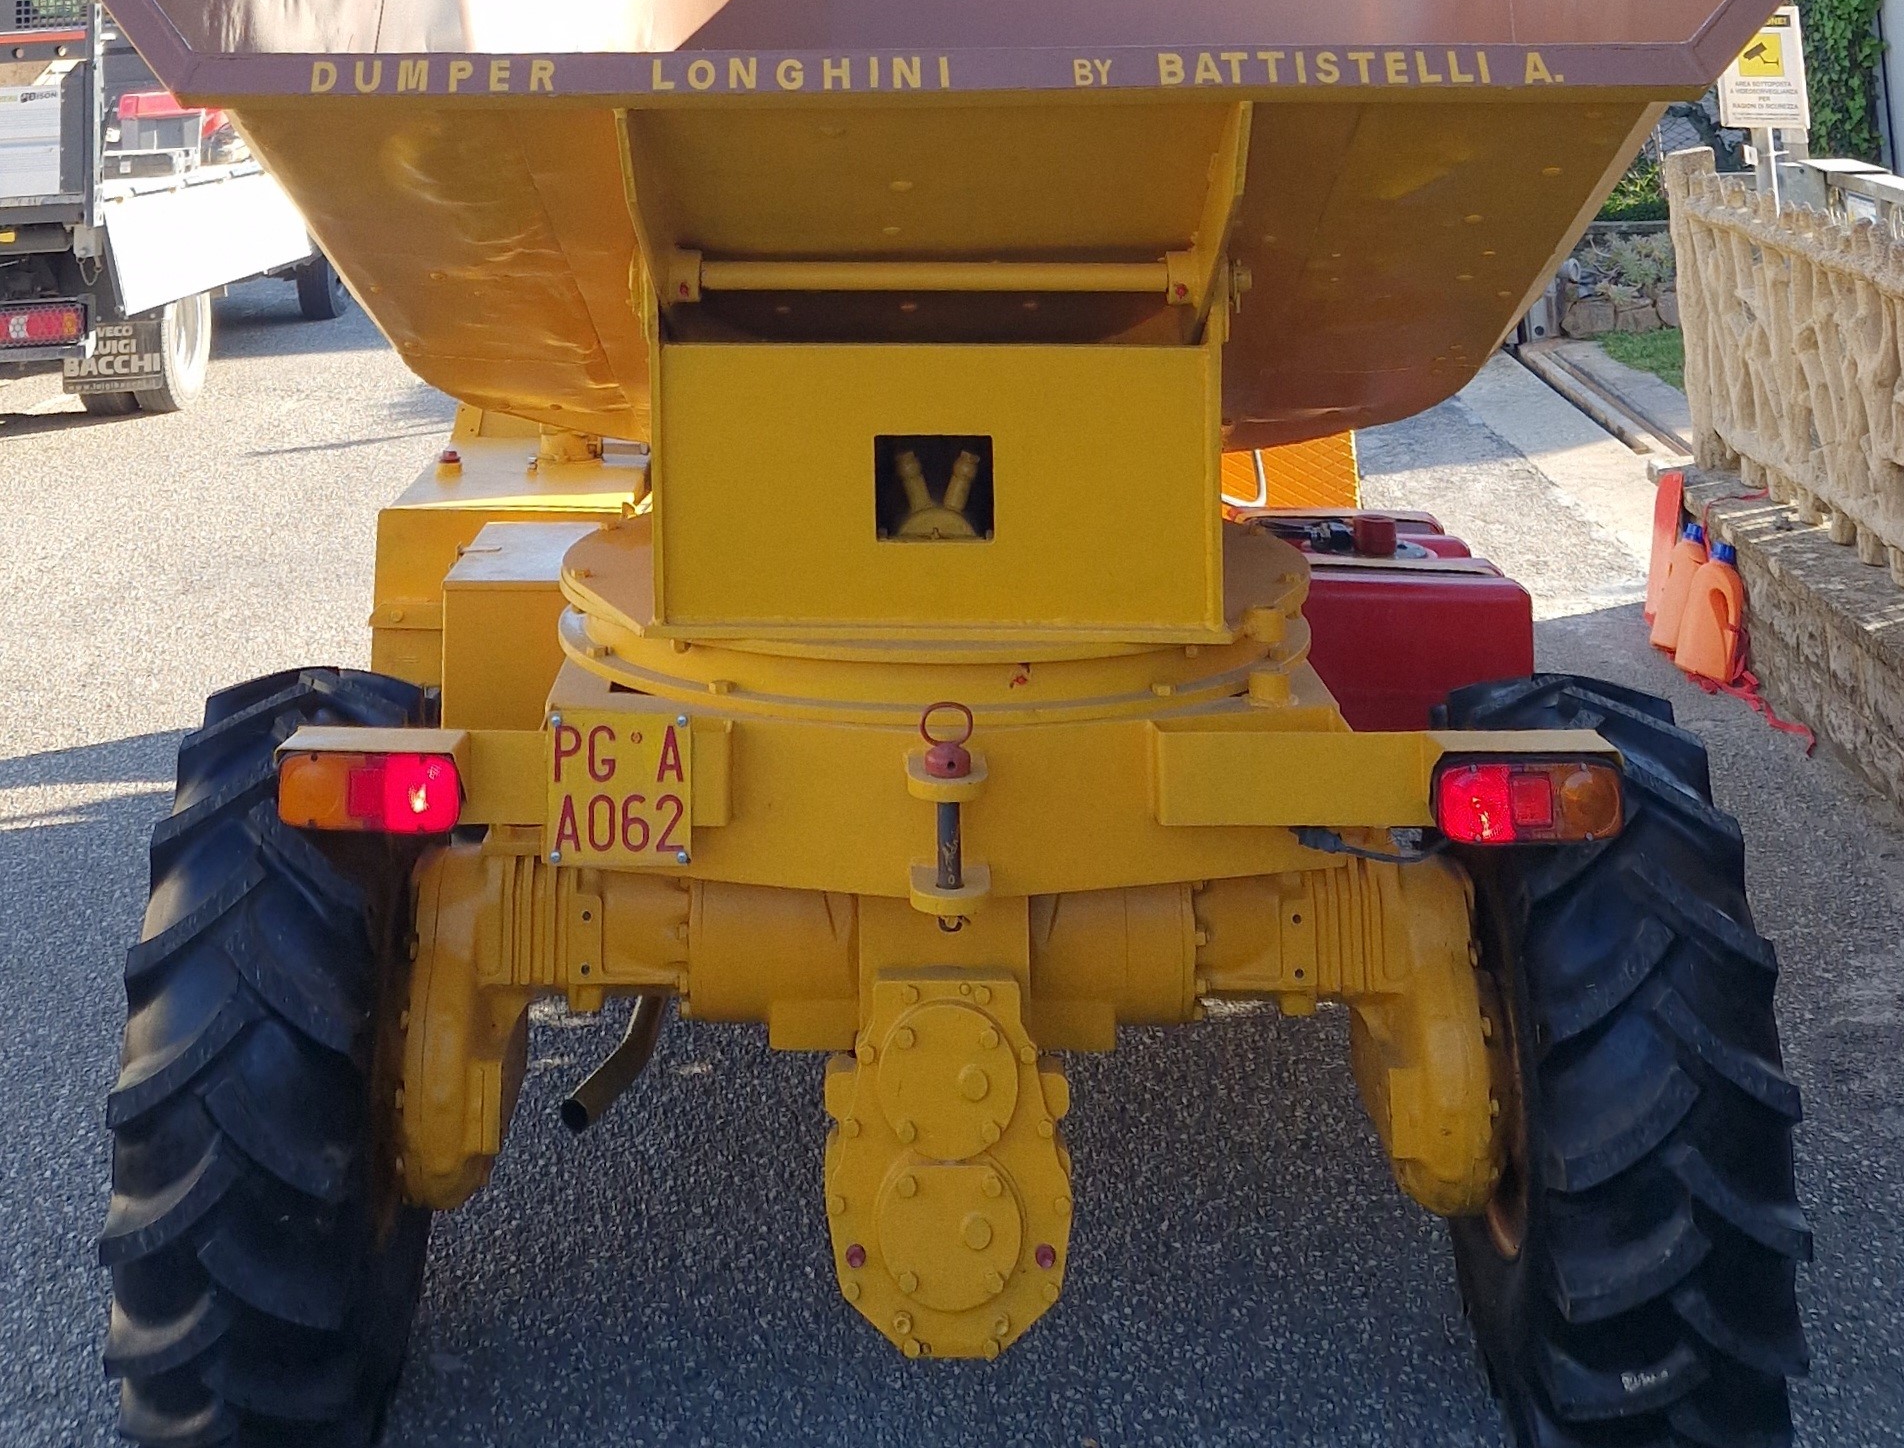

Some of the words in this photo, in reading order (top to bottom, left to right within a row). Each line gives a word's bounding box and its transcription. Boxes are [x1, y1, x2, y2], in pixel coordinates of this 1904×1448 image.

[310, 59, 556, 94] DUMPER
[652, 55, 951, 91] LONGHINI
[1072, 58, 1113, 87] BY
[1156, 50, 1492, 86] BATTISTELLI
[1523, 51, 1565, 85] A.
[96, 325, 134, 338] VECO
[63, 352, 161, 378] BACCHI
[553, 724, 617, 783] PG
[656, 724, 684, 783] A
[555, 793, 685, 853] A062
